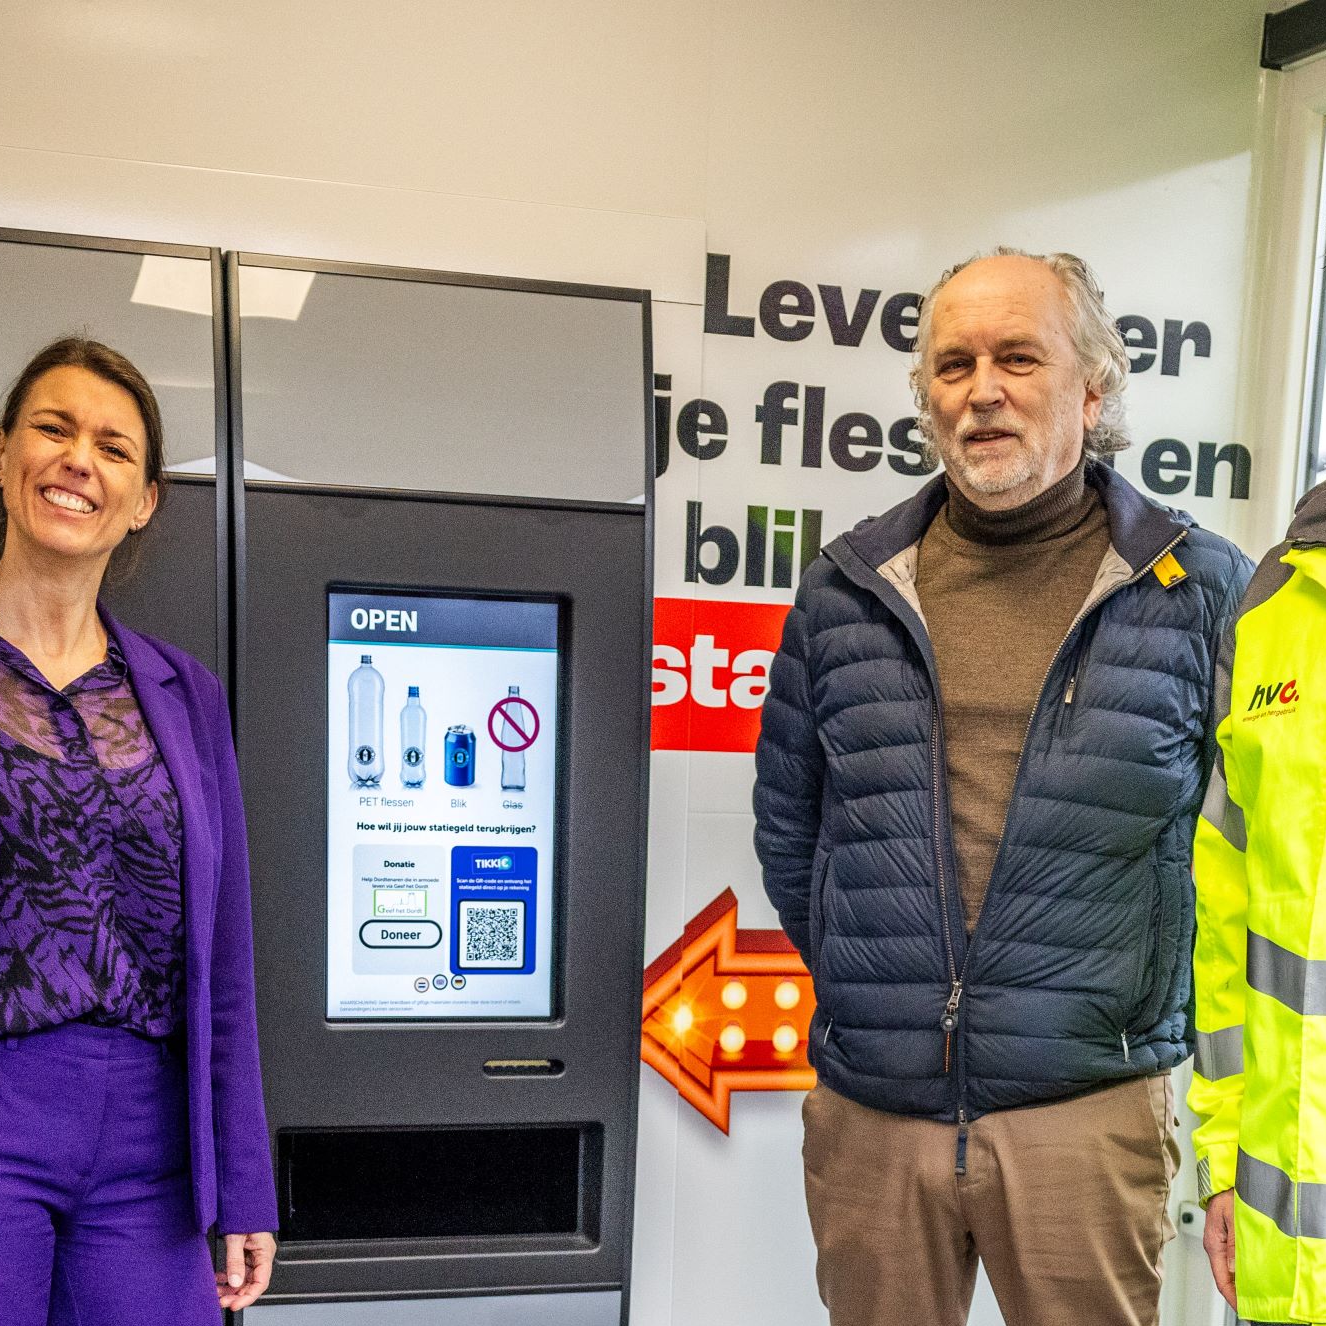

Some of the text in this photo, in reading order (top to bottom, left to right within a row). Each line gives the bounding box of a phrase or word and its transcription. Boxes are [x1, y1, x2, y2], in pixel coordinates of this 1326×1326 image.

[704, 252, 1212, 377] Leve er
[654, 372, 729, 479] je
[1141, 438, 1252, 500] en
[351, 608, 418, 632] OPEN
[651, 634, 776, 709] sta
[359, 797, 414, 807] PET flessen
[451, 799, 467, 808] Blik
[502, 800, 523, 809] Glas
[356, 822, 536, 834] Hoe wil jij jouw statiegeld terugkrijgen?
[384, 860, 415, 868] Donatie
[381, 930, 421, 940] Doneer
